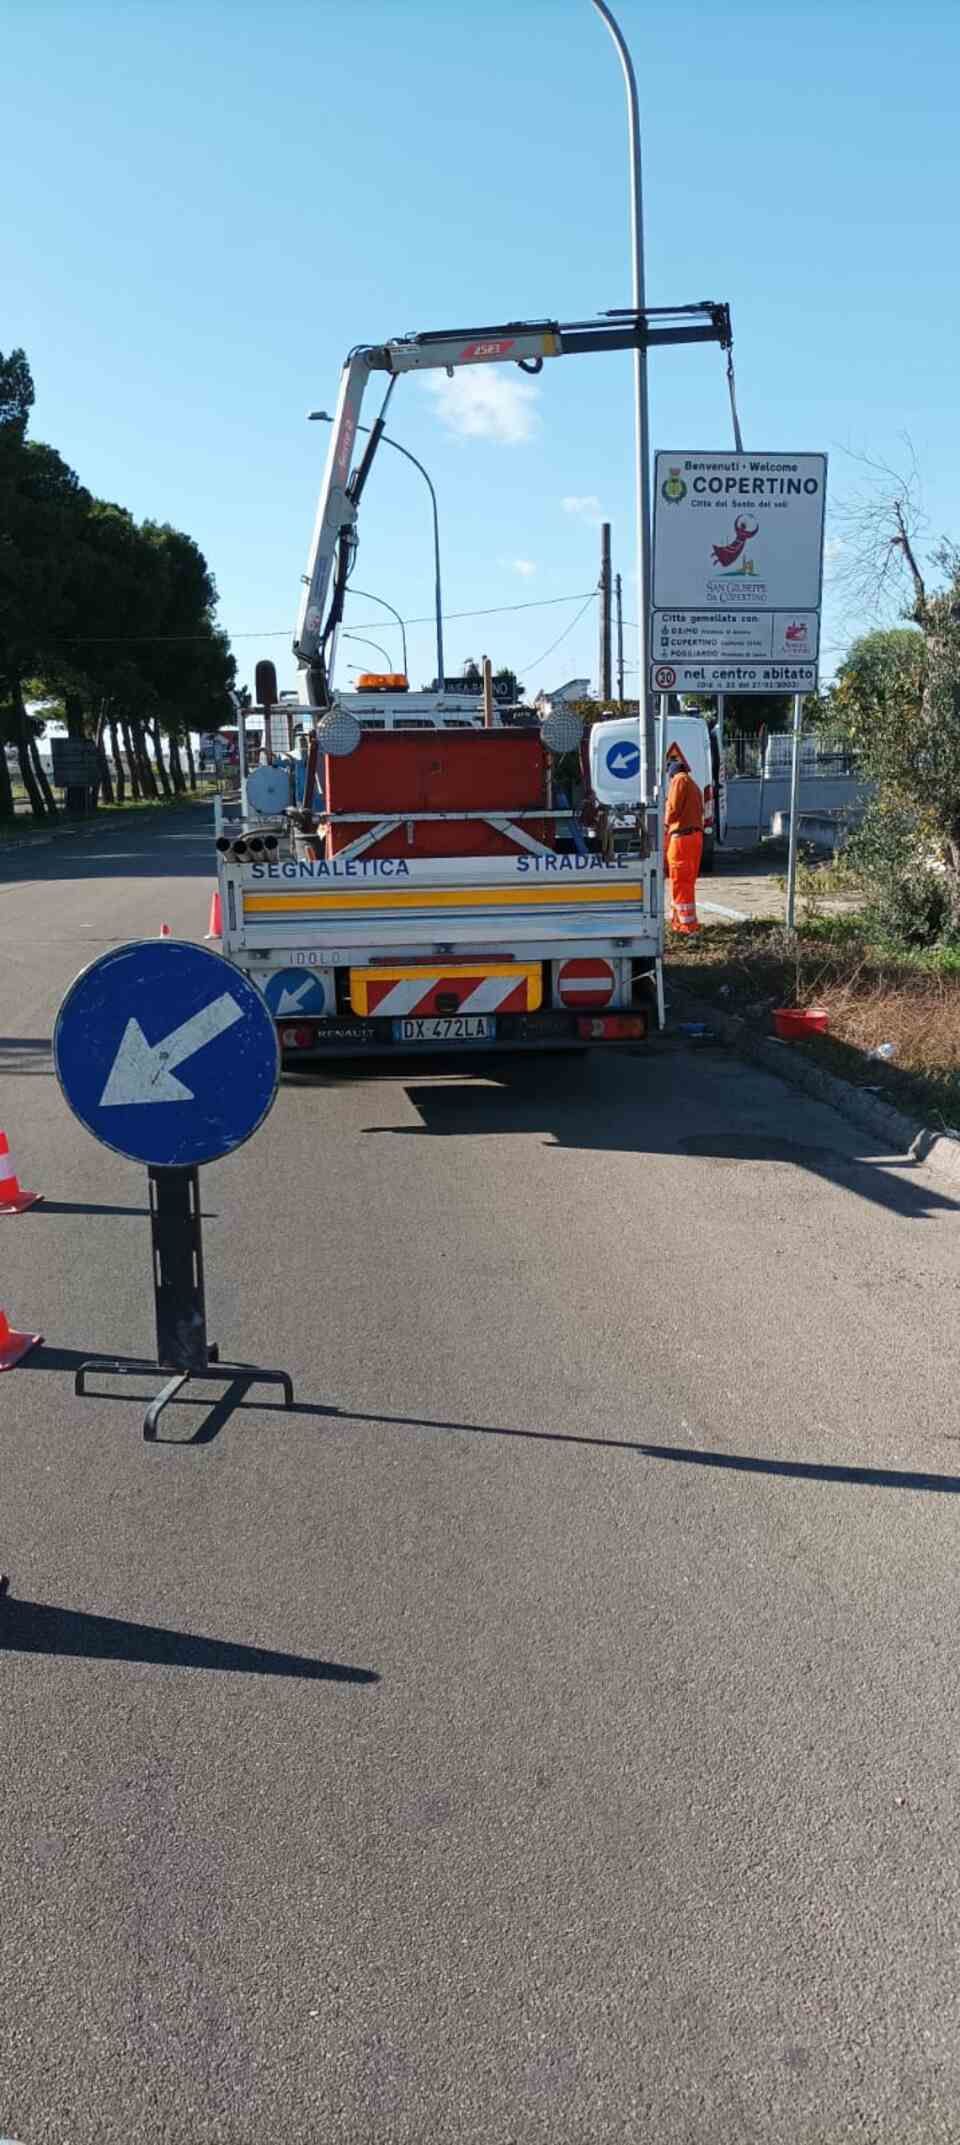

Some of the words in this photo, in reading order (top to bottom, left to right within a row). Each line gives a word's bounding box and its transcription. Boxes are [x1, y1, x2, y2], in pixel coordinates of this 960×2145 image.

[684, 461, 739, 471] Benvenuti
[750, 462, 798, 472] Welcome
[692, 476, 818, 495] COPERTINO
[660, 671, 672, 683] 30
[684, 667, 705, 679] nel
[712, 667, 757, 679] centro
[763, 667, 813, 680] abitato
[251, 858, 410, 879] SEGNALETICA
[516, 853, 629, 873] STRADALE
[317, 1029, 376, 1040] RENAULT
[404, 1020, 425, 1039] DX
[432, 1018, 486, 1038] 472LA
